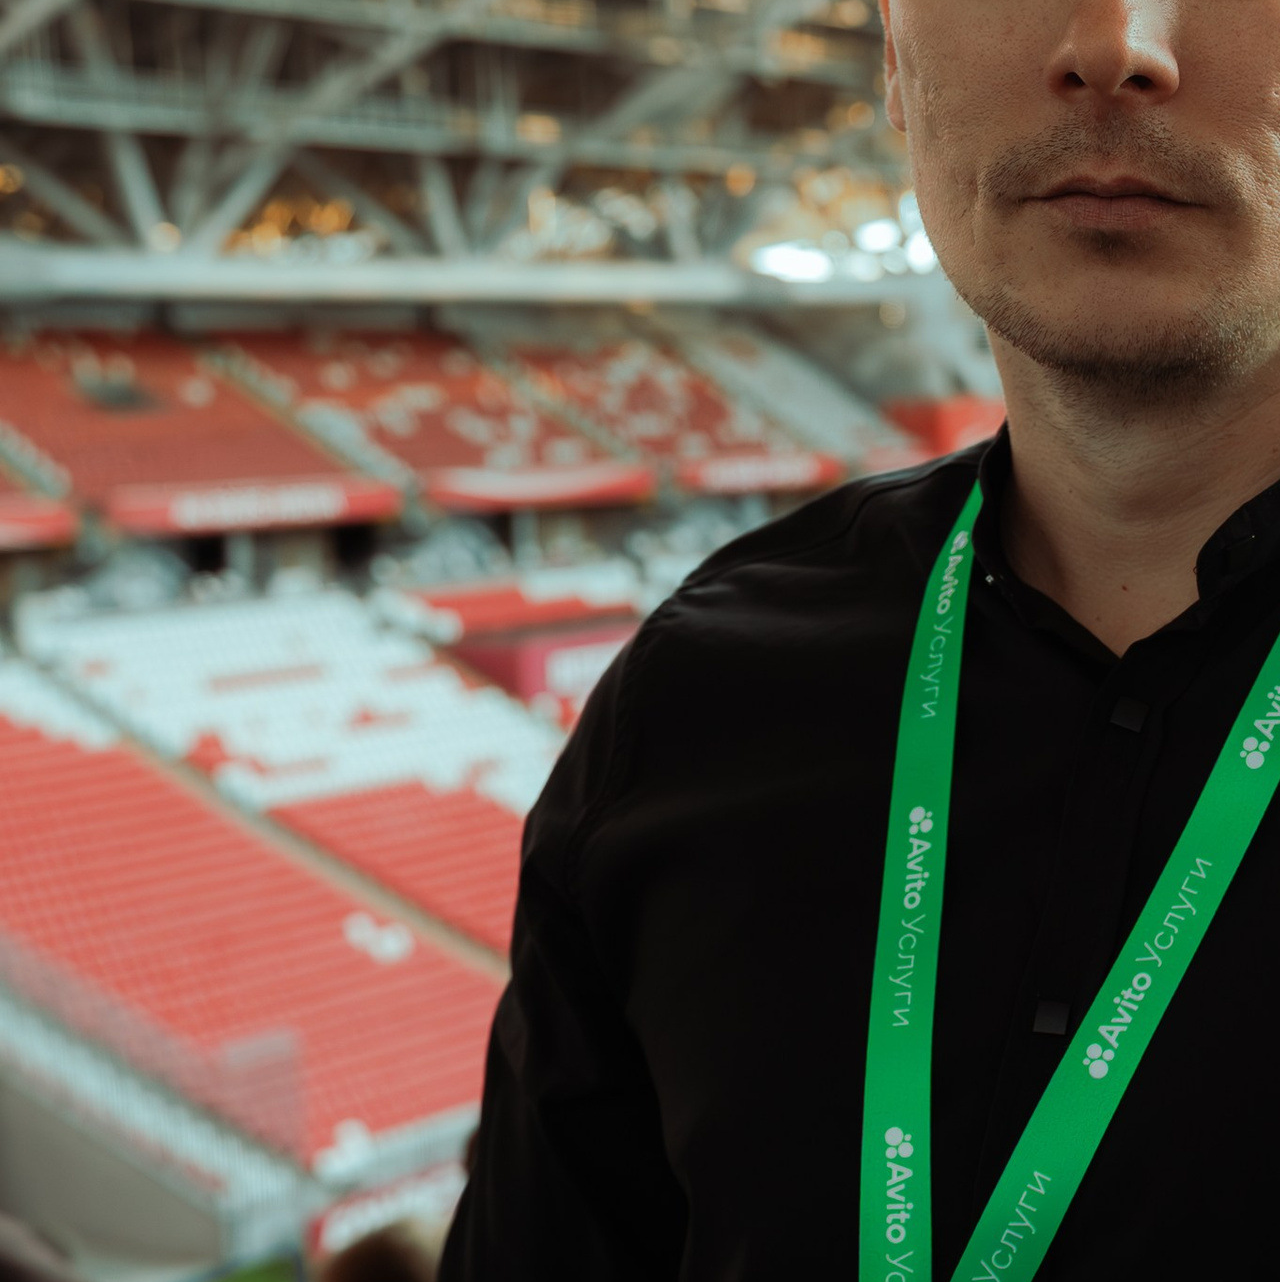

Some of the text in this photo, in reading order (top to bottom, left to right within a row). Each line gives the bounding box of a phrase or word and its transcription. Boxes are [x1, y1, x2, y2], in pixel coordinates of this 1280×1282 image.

[920, 554, 964, 718] Avito Услуги
[888, 837, 932, 1027] Avito Услуги
[1097, 857, 1213, 1049] Avito Услуги
[885, 1161, 914, 1244] Avito
